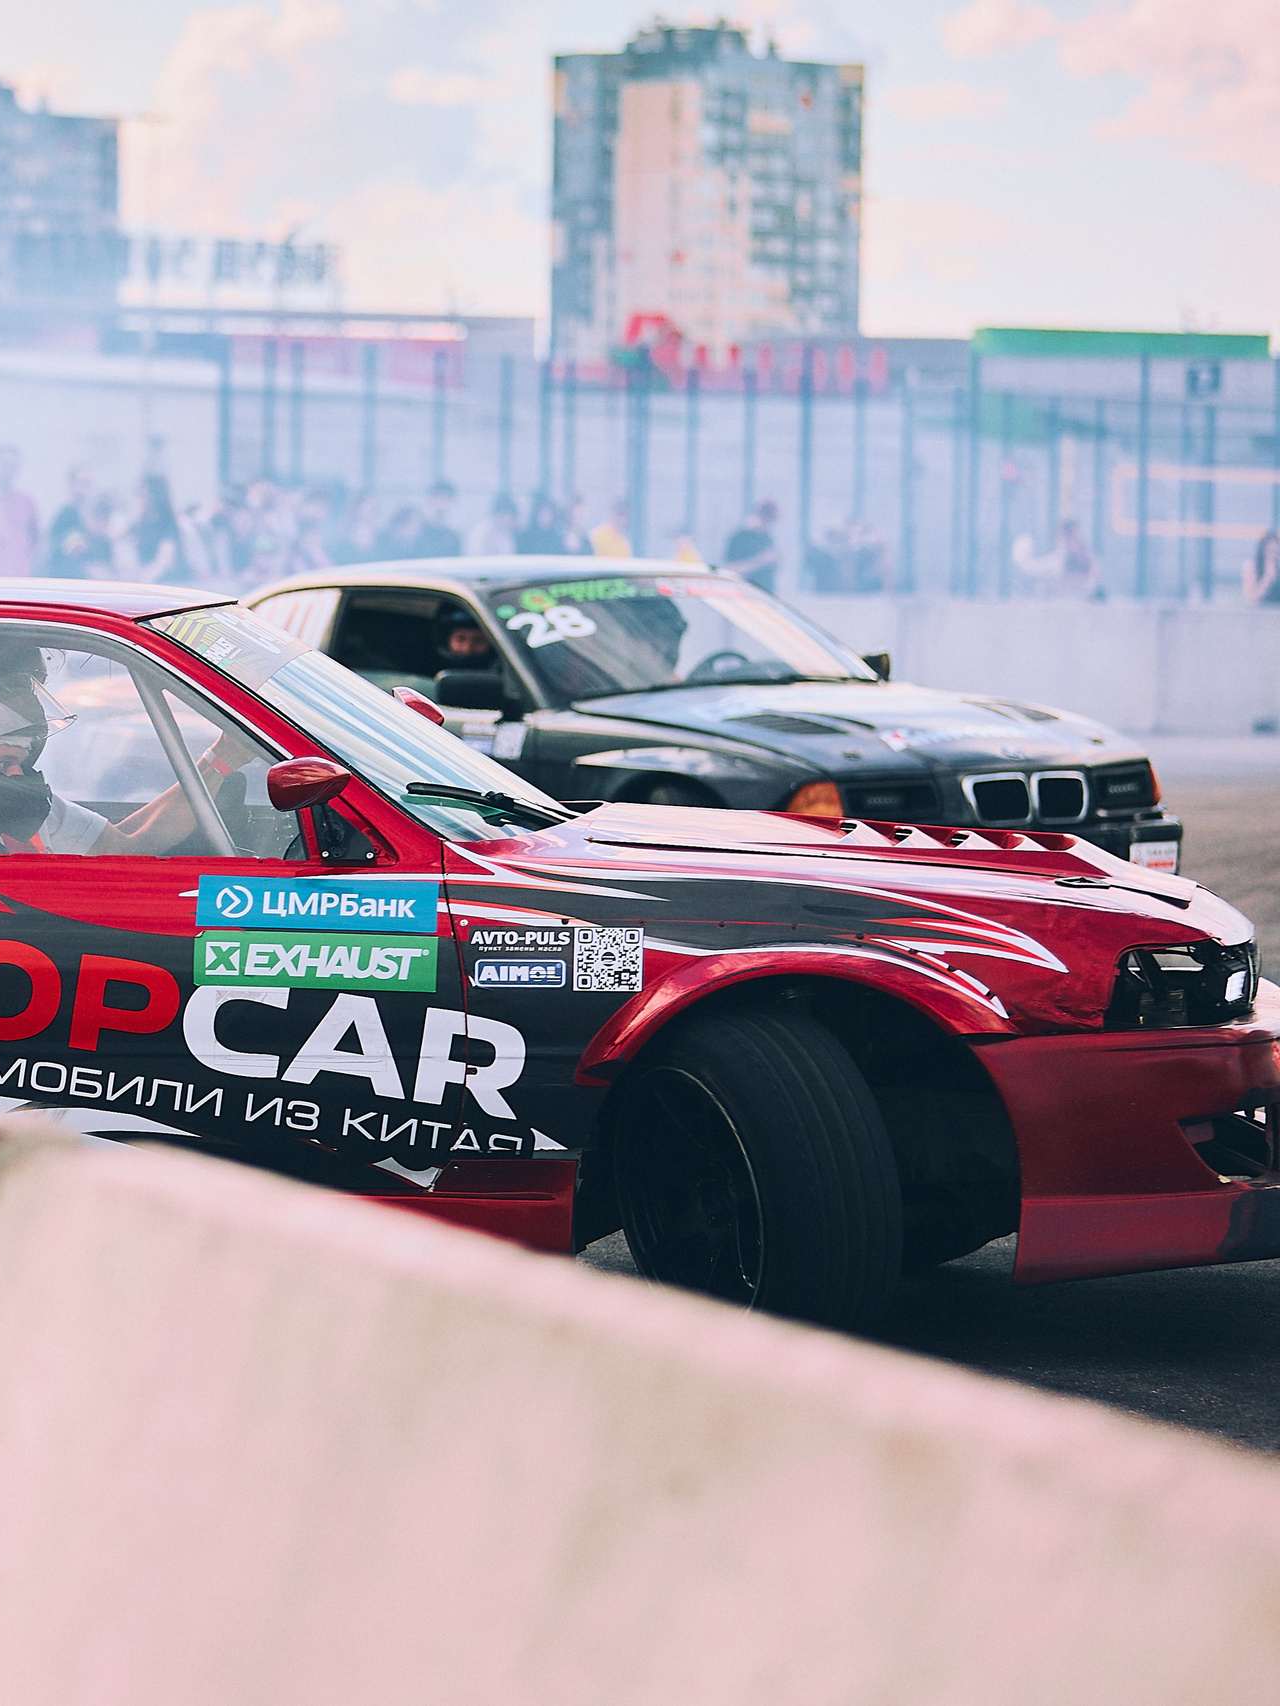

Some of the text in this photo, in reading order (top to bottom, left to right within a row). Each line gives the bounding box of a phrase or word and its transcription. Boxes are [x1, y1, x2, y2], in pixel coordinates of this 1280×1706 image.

[506, 604, 597, 649] 28
[261, 891, 417, 919] ЦМРБанк
[470, 931, 571, 945] AVTO-PULS
[244, 943, 423, 980] EXHAUST
[479, 965, 562, 982] AIMOL
[245, 1093, 320, 1132] ИЗ
[341, 1107, 524, 1152] КИТАЯ
